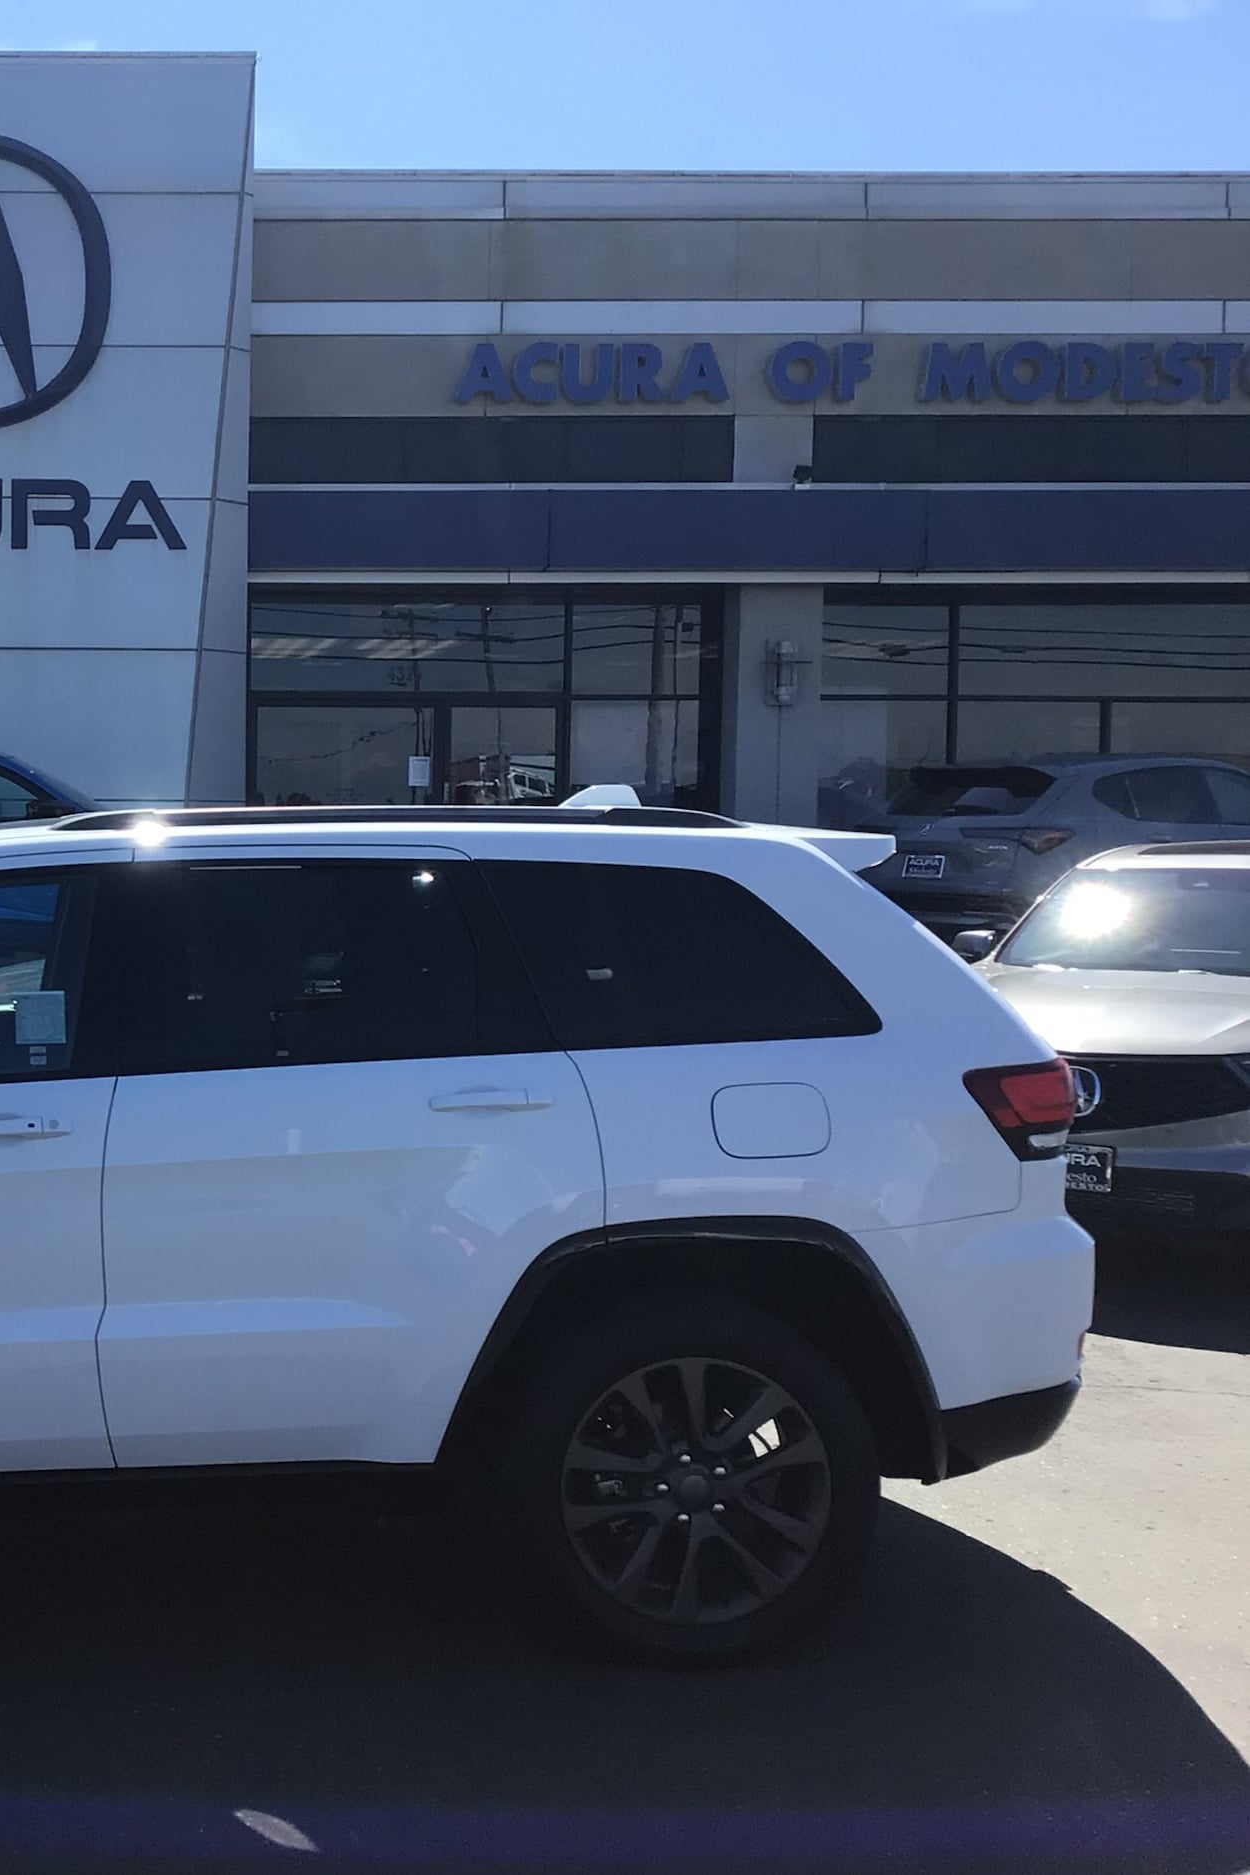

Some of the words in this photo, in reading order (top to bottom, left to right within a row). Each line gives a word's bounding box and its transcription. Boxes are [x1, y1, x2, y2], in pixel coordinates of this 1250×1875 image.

[456, 341, 730, 401] ACURA
[766, 341, 874, 401] OF
[922, 342, 1250, 402] MODEST
